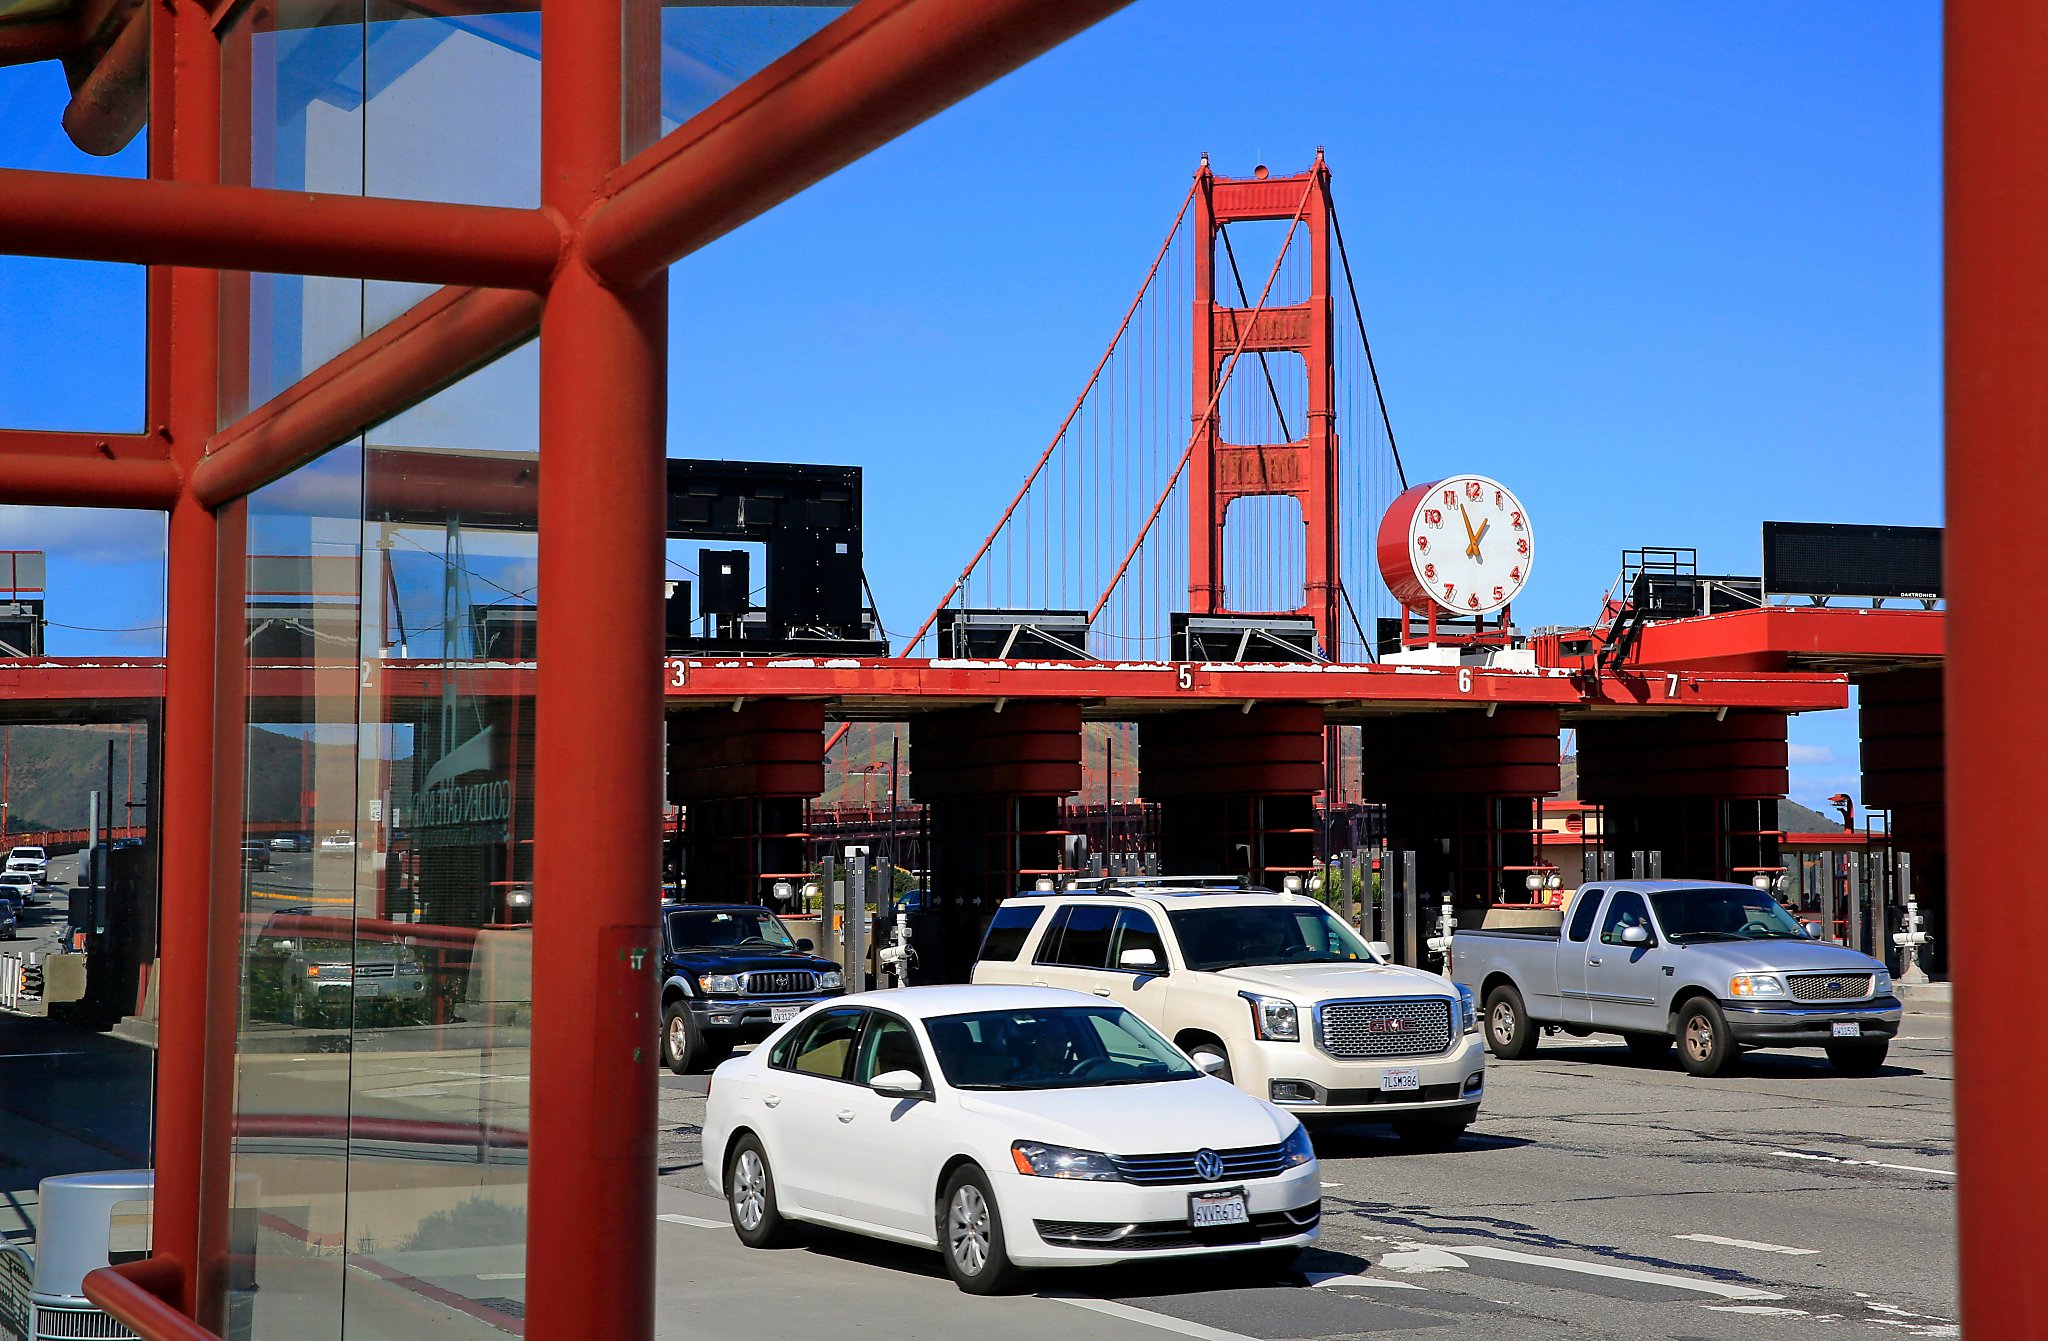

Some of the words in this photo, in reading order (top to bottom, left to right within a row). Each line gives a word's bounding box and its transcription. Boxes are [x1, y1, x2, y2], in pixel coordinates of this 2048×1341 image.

[1466, 482, 1481, 497] 12
[1444, 491, 1456, 505] 11
[1495, 491, 1501, 505] 1
[1424, 510, 1442, 524] 10
[1510, 511, 1521, 526] 2
[1418, 536, 1428, 550] 9
[1517, 539, 1528, 554] 3
[1425, 563, 1435, 578] 8
[1510, 566, 1520, 580] 4
[1444, 584, 1455, 598] 7
[1493, 586, 1503, 600] 5
[1468, 593, 1479, 608] 6
[361, 661, 373, 688] 2
[671, 660, 685, 687] 3
[1179, 664, 1192, 689] 5
[1458, 668, 1471, 693] 6
[1666, 673, 1678, 697] 7
[1369, 1018, 1417, 1033] GMC
[1383, 1075, 1417, 1088] 7LSM386
